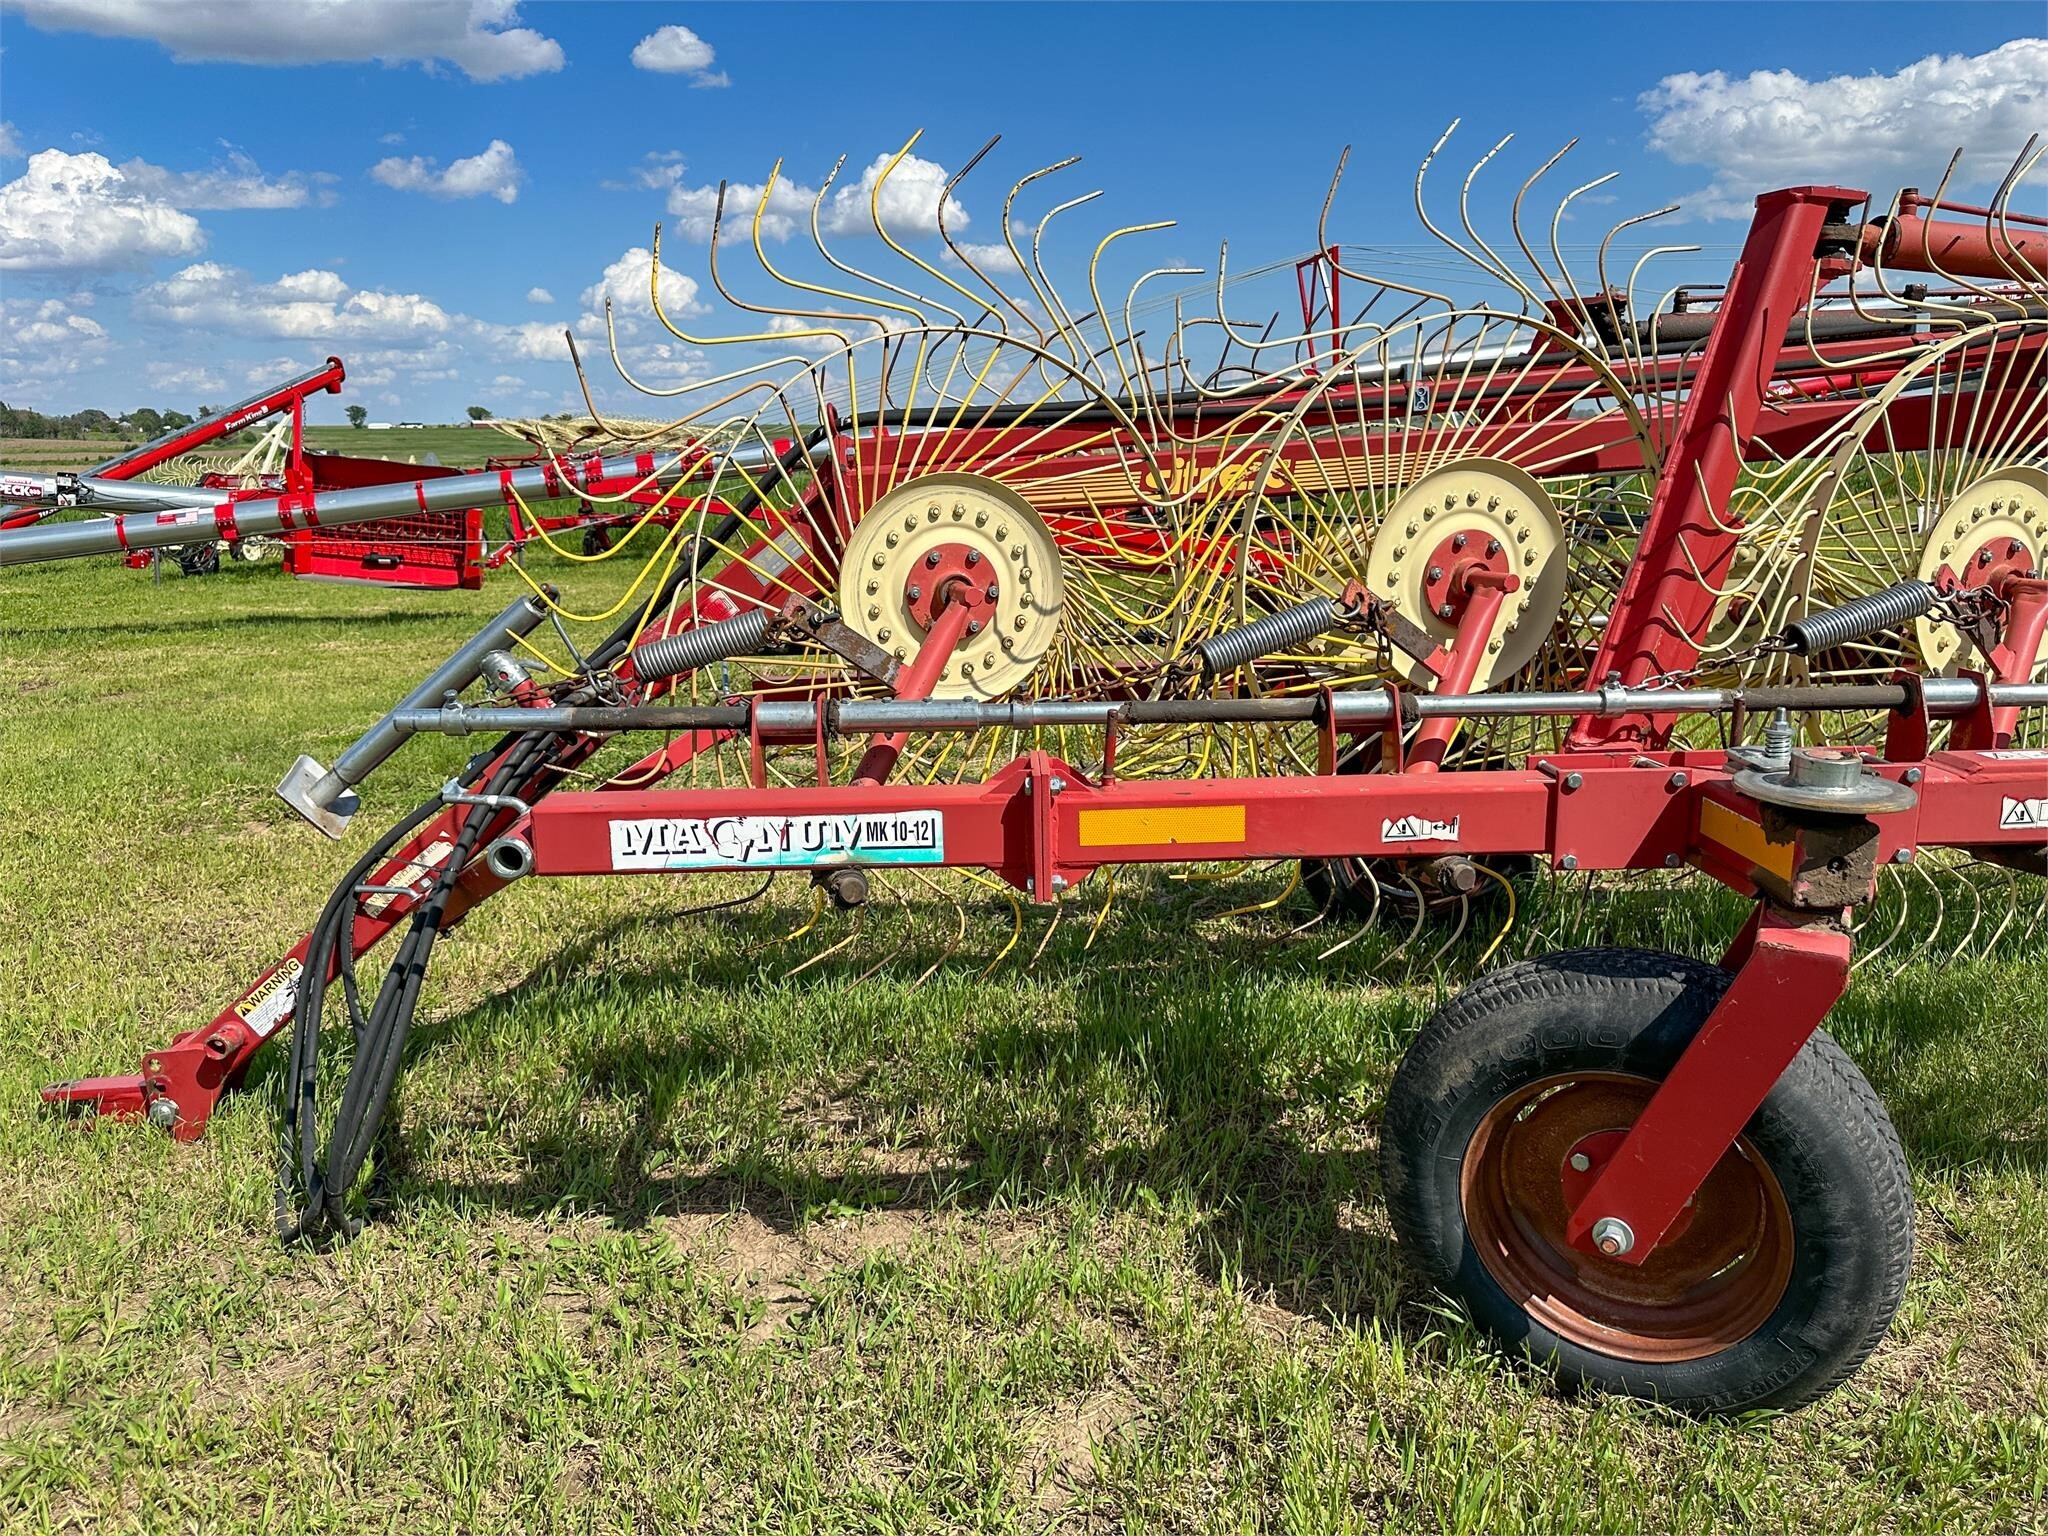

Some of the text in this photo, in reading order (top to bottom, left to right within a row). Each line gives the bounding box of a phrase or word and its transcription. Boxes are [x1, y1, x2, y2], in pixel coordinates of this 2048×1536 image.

[620, 817, 930, 862] MAGNUM MK 10-12
[247, 960, 299, 1007] WARNING
